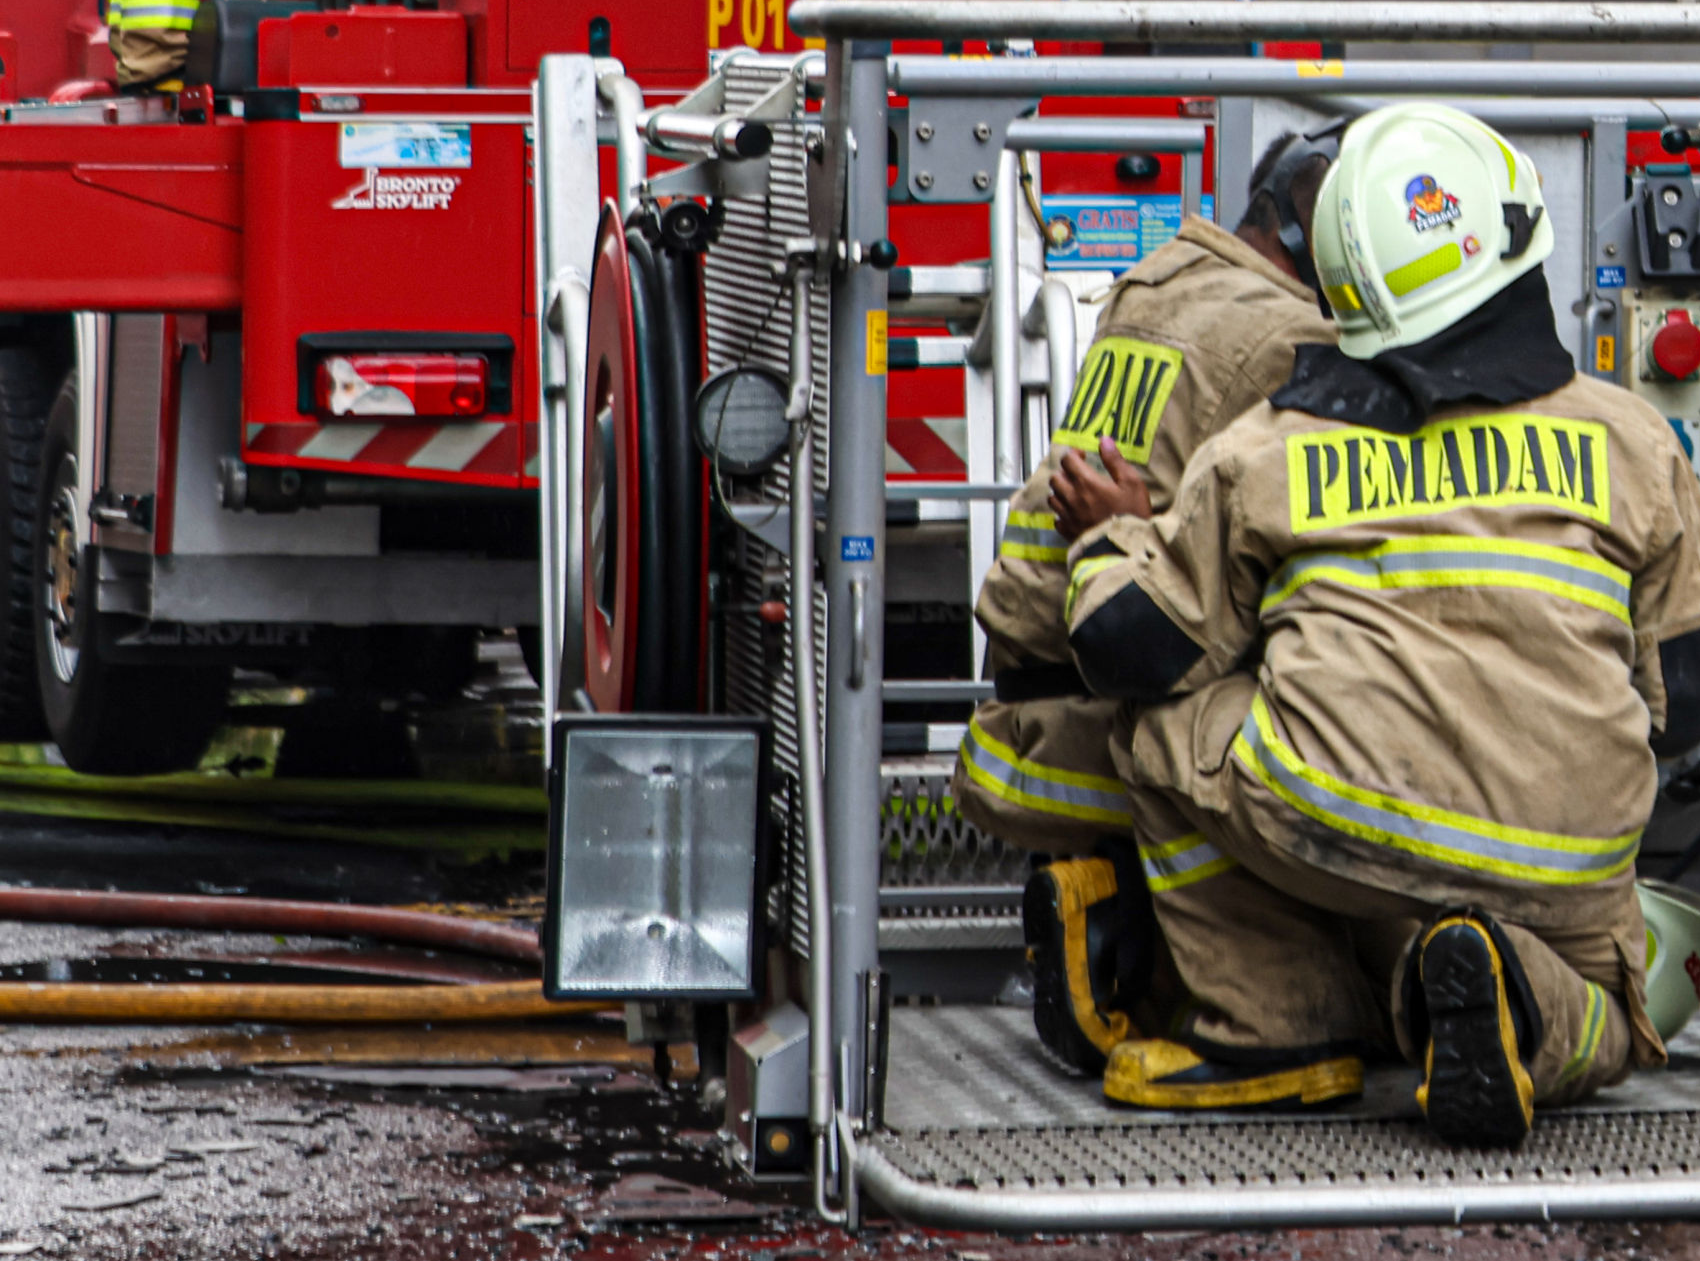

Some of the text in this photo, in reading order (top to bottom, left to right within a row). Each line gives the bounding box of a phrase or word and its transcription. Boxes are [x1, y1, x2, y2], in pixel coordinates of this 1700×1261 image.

[376, 193, 451, 210] SKYLIFT
[1416, 208, 1461, 232] PEMADAM
[1303, 426, 1598, 520] PEMADAM
